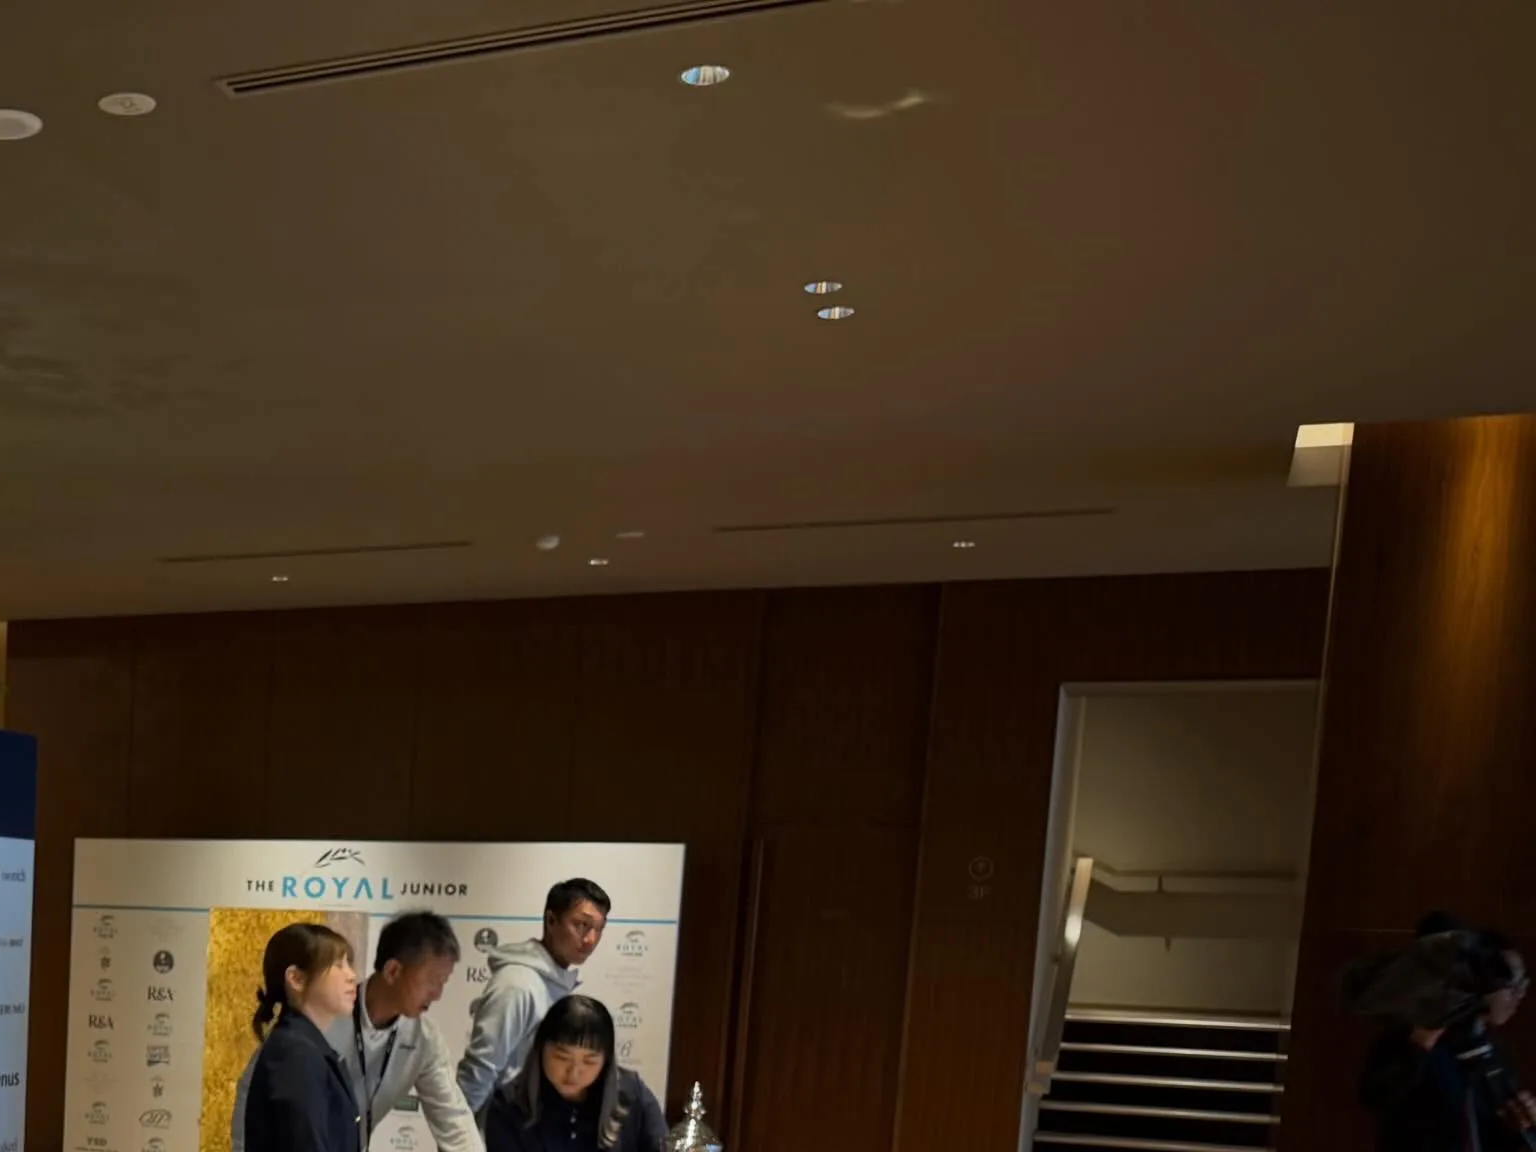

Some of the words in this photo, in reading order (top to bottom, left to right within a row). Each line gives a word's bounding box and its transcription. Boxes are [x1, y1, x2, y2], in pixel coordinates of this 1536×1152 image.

[247, 879, 274, 892] THE
[281, 876, 394, 900] ROYAL
[400, 883, 468, 897] JUNIOR
[147, 986, 174, 1001] R&A
[88, 1014, 114, 1029] R&A
